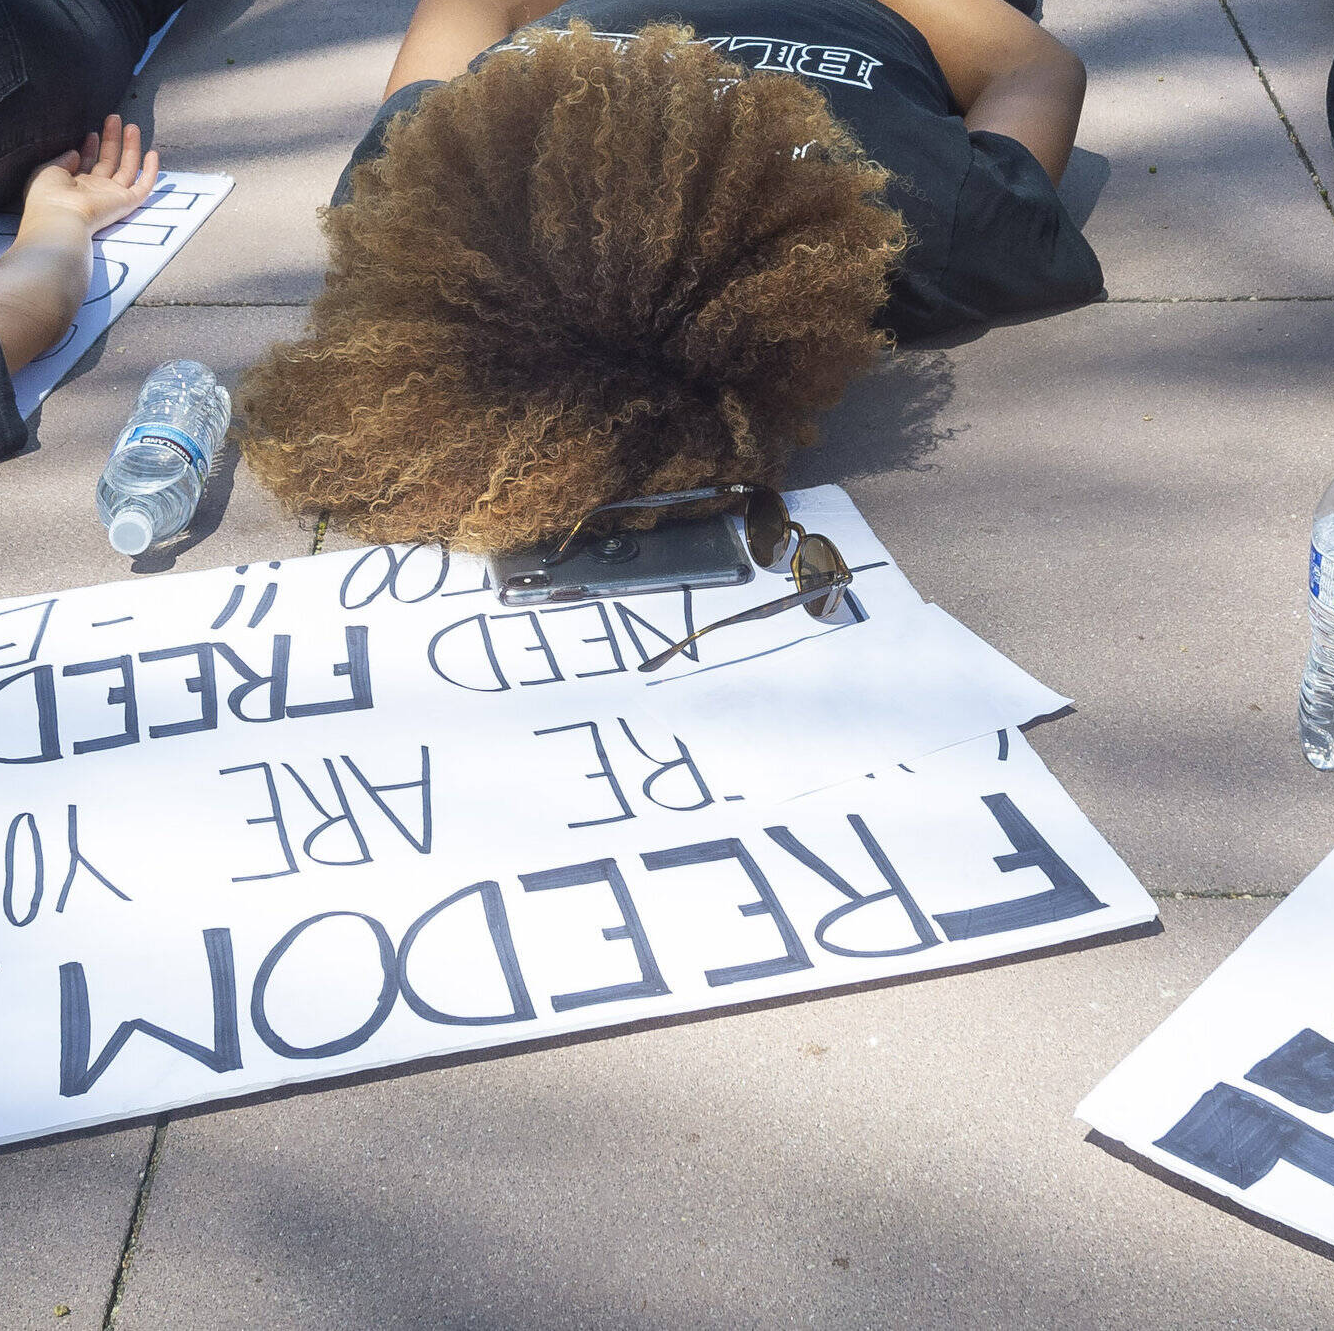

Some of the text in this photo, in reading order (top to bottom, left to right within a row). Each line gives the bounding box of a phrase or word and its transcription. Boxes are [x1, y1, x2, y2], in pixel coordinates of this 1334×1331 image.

[141, 437, 191, 464] KIRKLAND
[427, 588, 700, 693] NEED
[219, 745, 432, 882] ARE
